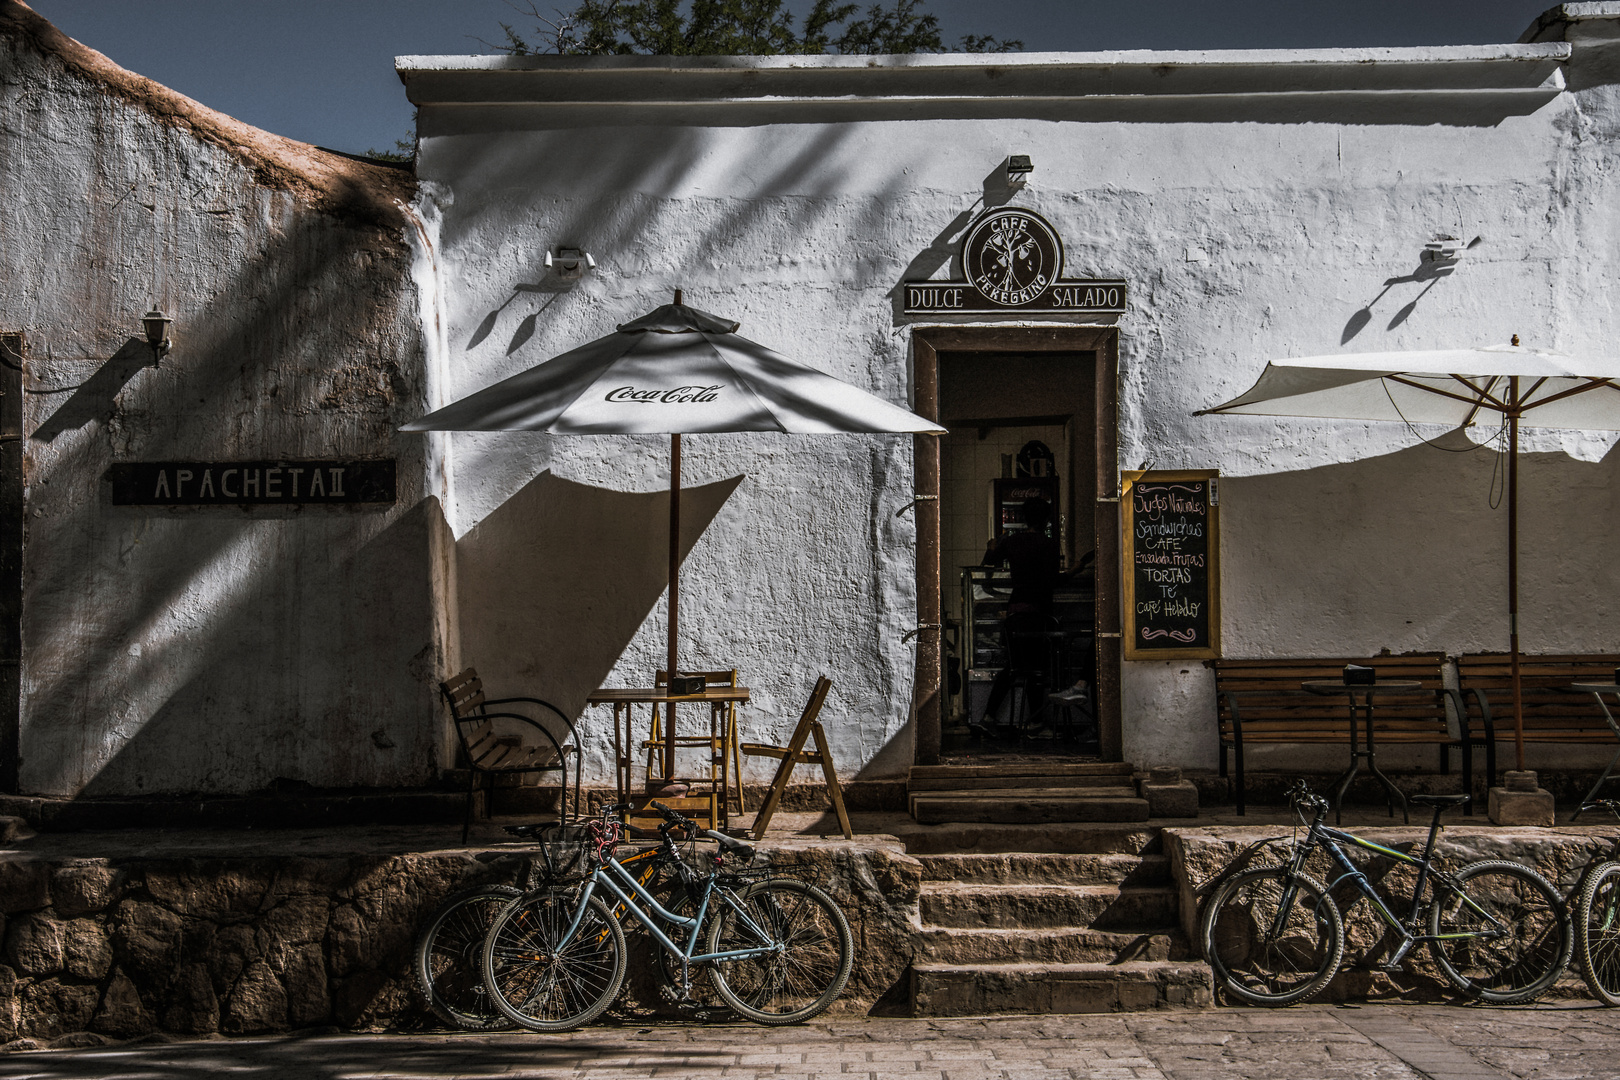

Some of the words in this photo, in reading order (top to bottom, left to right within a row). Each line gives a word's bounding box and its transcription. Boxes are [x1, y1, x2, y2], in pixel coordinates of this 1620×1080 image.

[990, 217, 1029, 233] CAFE
[909, 288, 964, 308] DULCE
[1052, 287, 1119, 308] SALADO
[975, 273, 1047, 304] PEREGRINO
[1133, 494, 1168, 520] Jugos
[1168, 492, 1206, 515] Naturales
[1136, 515, 1203, 538] Sandwiches
[1142, 567, 1192, 584] TORTAS
[1158, 584, 1178, 598] Té
[1163, 596, 1201, 618] Helado
